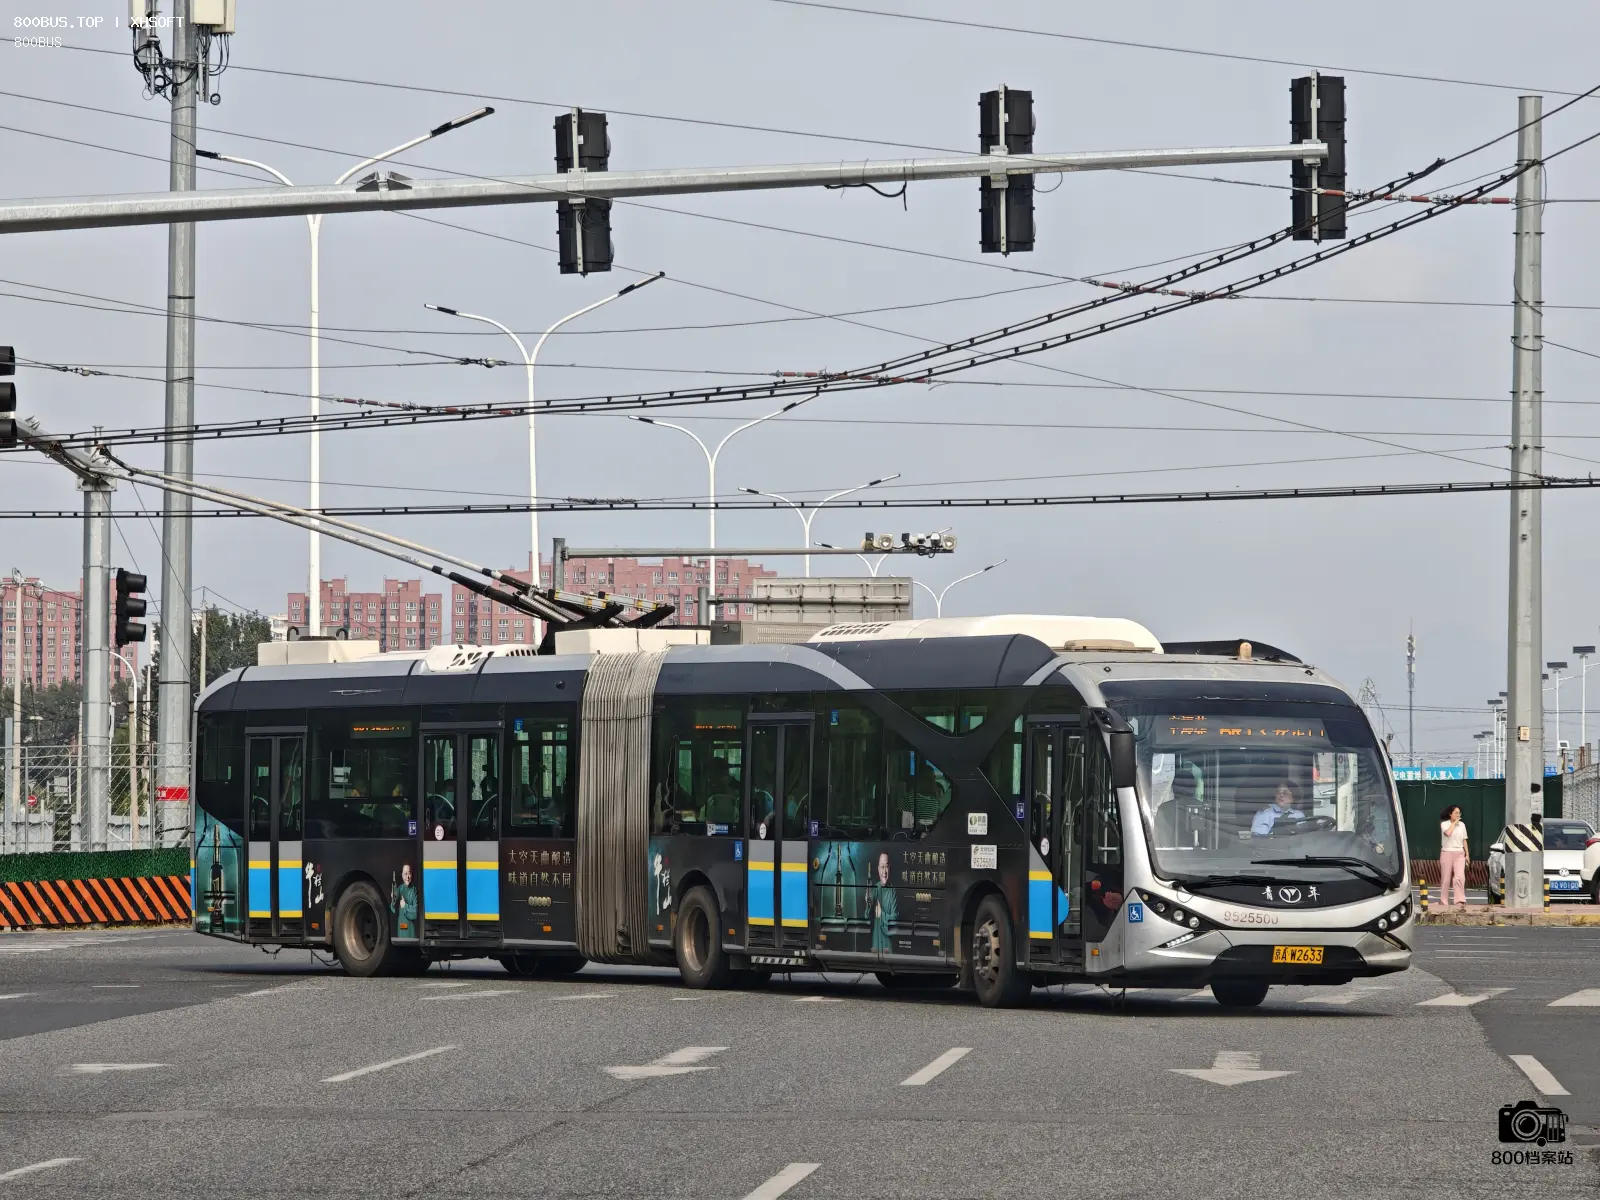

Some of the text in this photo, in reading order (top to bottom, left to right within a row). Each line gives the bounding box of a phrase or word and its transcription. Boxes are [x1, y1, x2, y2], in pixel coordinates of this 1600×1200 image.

[507, 870, 572, 888] 味道自然不同
